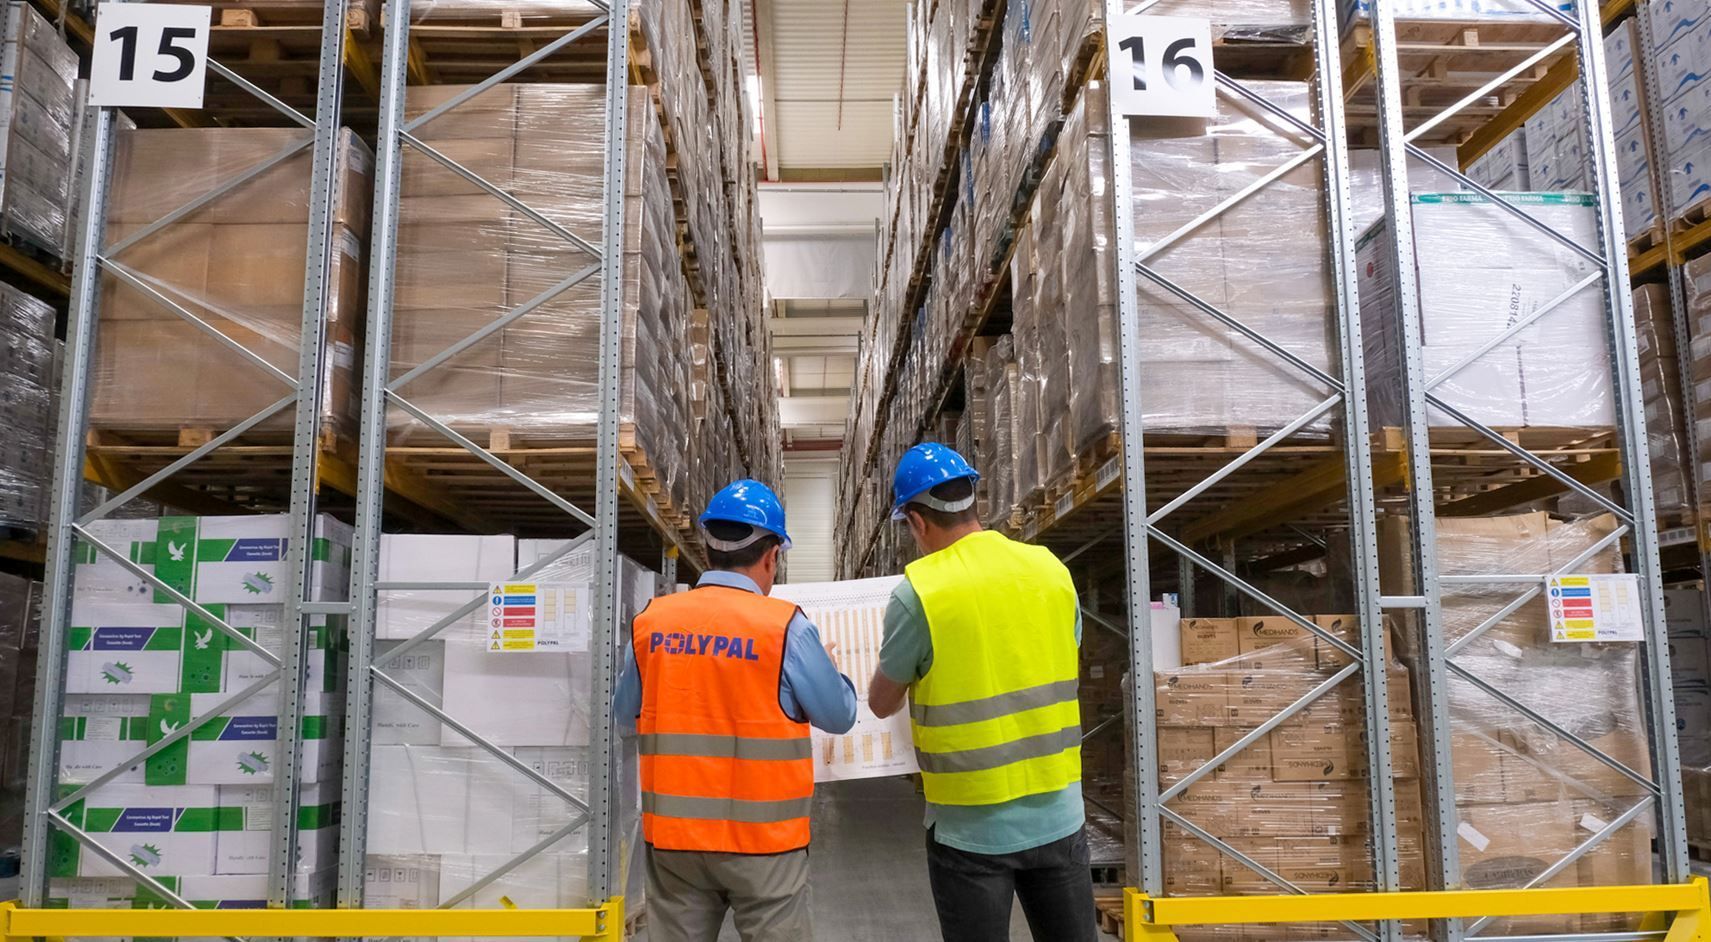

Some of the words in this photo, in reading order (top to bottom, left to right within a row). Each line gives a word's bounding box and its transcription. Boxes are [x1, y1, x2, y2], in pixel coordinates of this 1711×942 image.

[110, 26, 196, 82] 15
[1119, 36, 1204, 92] 16
[650, 631, 759, 661] POLYPAL
[1259, 628, 1299, 636] MEDIHANDS
